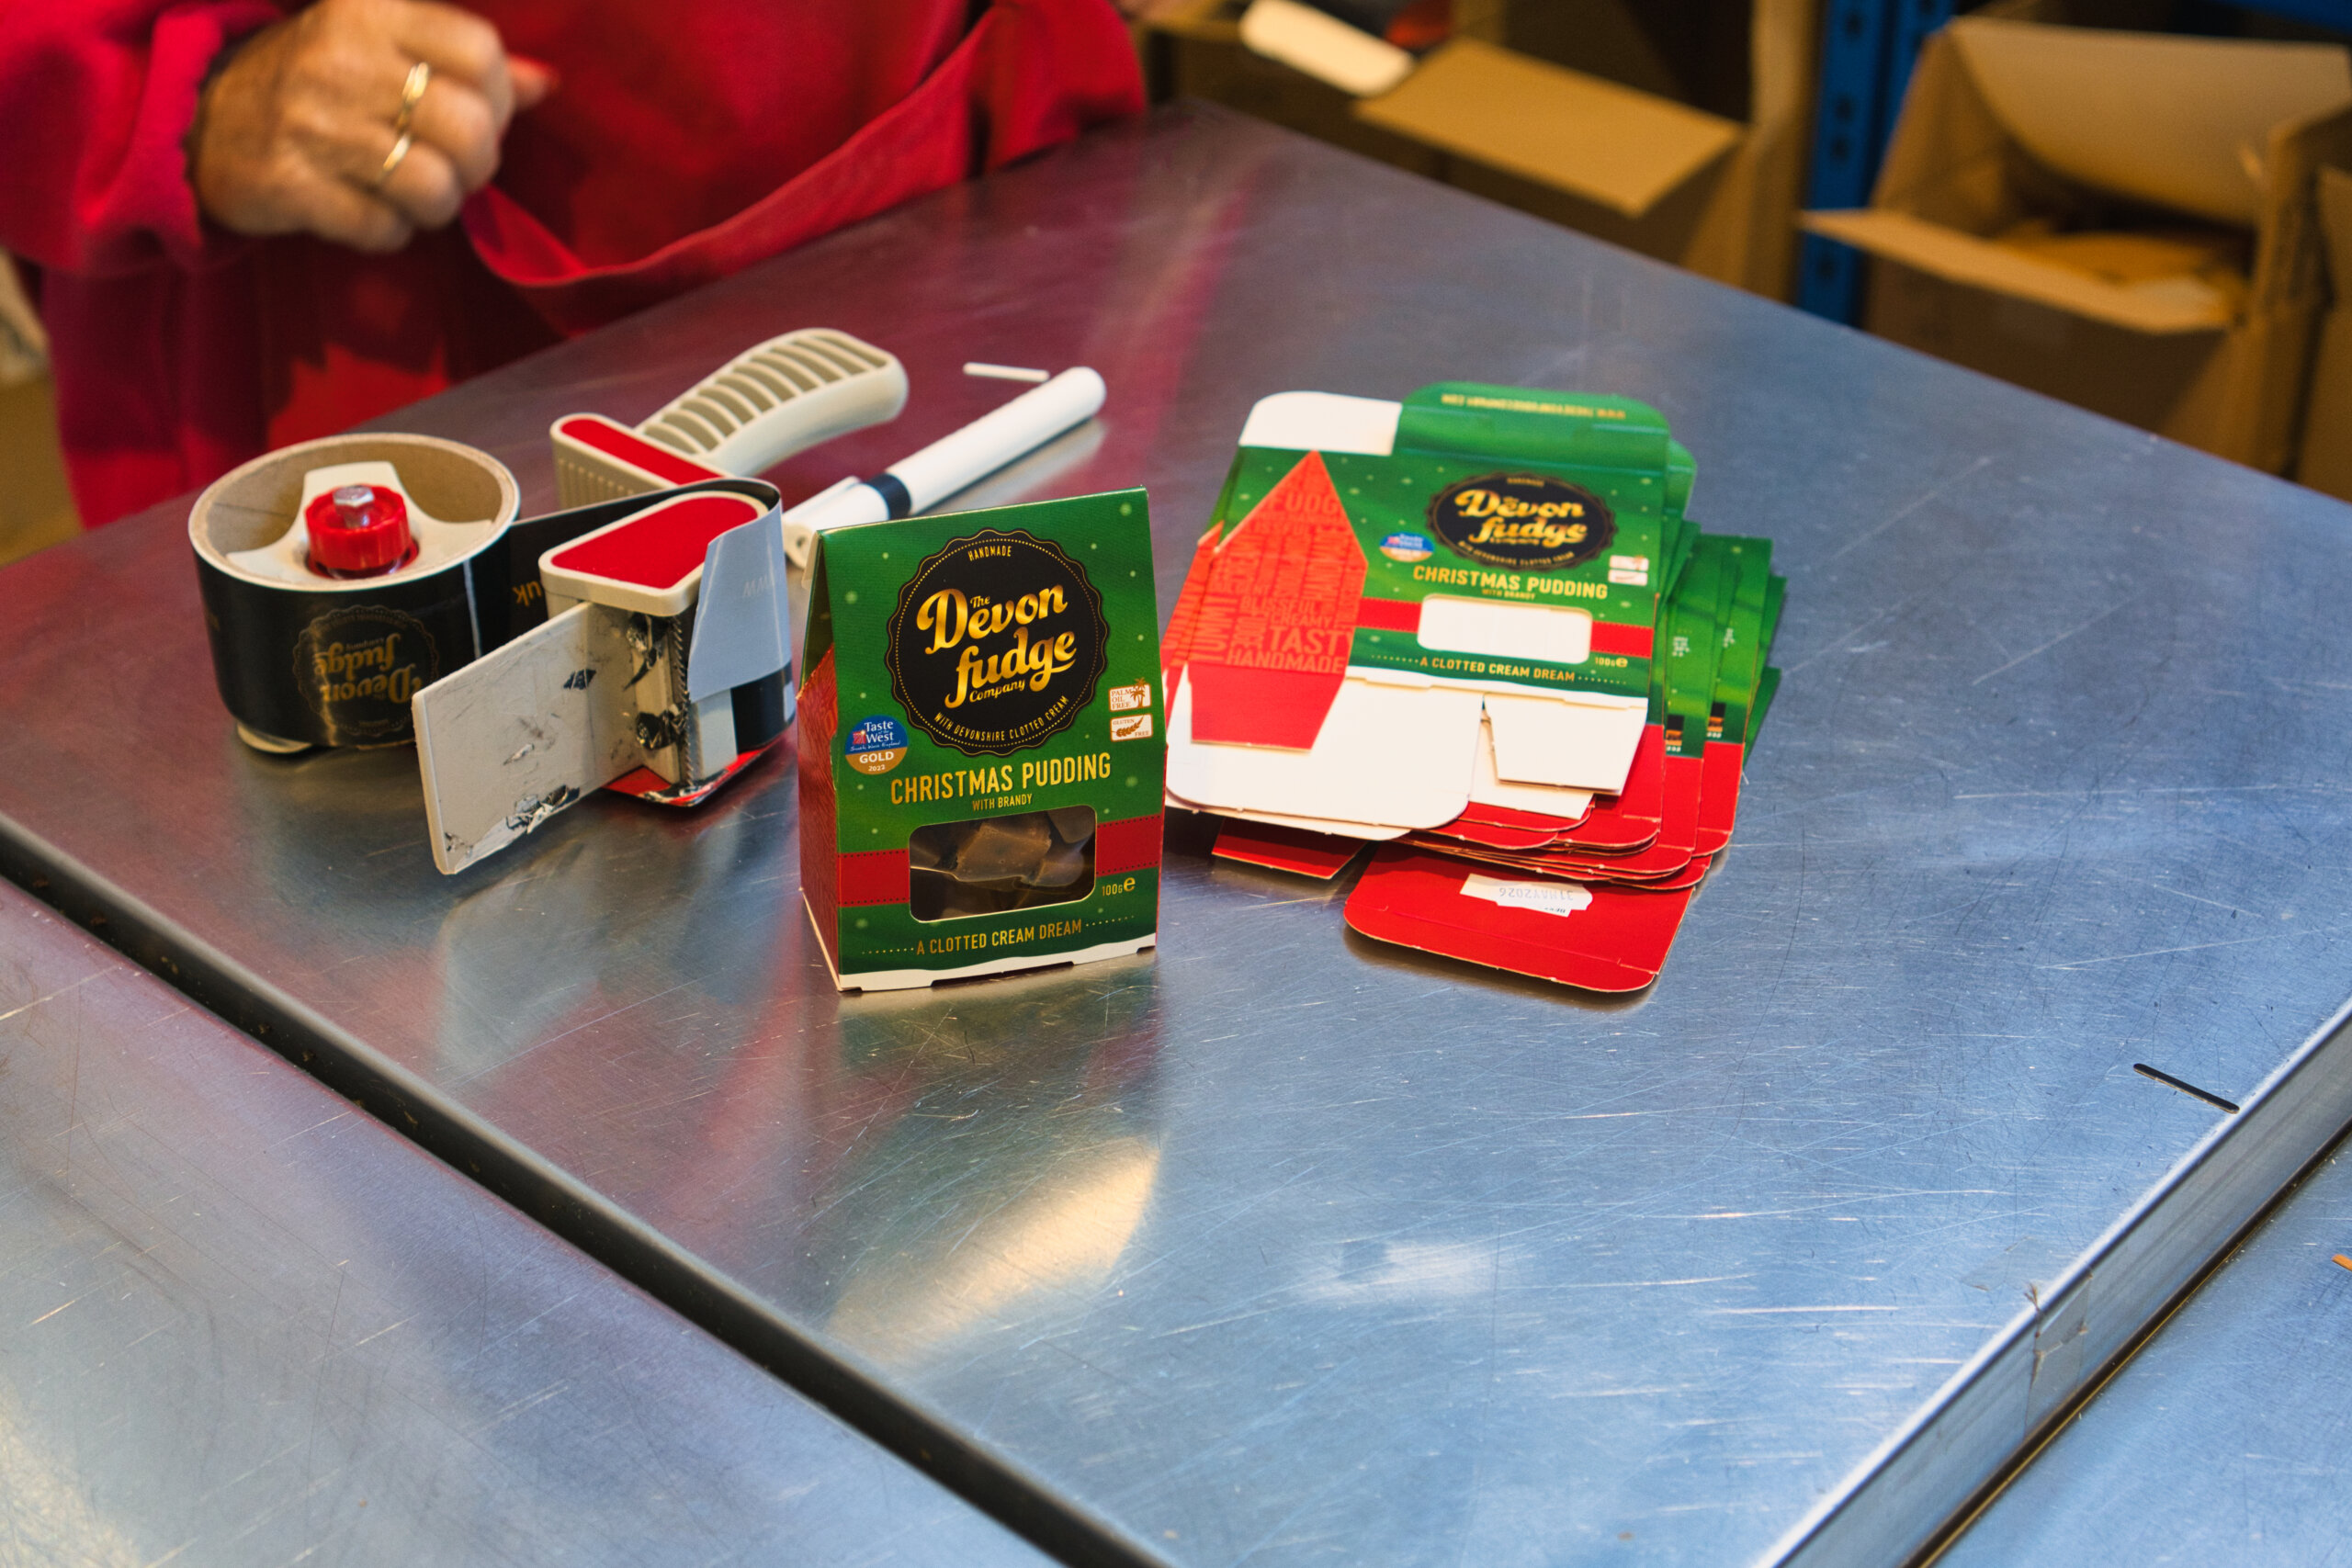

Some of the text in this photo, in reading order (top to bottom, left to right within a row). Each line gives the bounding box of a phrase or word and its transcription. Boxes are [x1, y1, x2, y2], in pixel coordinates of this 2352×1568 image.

[1454, 489, 1585, 517] Devon
[1468, 516, 1588, 548] fudge
[967, 545, 1012, 561] HANDMADE
[1413, 565, 1608, 599] CHRISTMAS PUDDING
[970, 595, 990, 609] The
[916, 584, 1069, 655] Devon
[313, 633, 401, 682] fudge
[944, 626, 1077, 709] fudge
[1227, 649, 1346, 674] HANDMADE
[1419, 657, 1576, 682] A CLOTTED CREAM DREAM
[320, 663, 423, 704] Devon
[969, 679, 1025, 703] Company
[865, 721, 894, 732] Taste
[934, 695, 1069, 742] WITH DEVONSHIRE CLOTTED CREAM
[865, 732, 894, 743] West
[859, 751, 894, 763] GOLD
[890, 751, 1112, 805] CHRISTMAS PUDDING
[972, 794, 1033, 812] WITH BRANDY
[916, 919, 1082, 956] A CLOTTED CREAM DREAM
